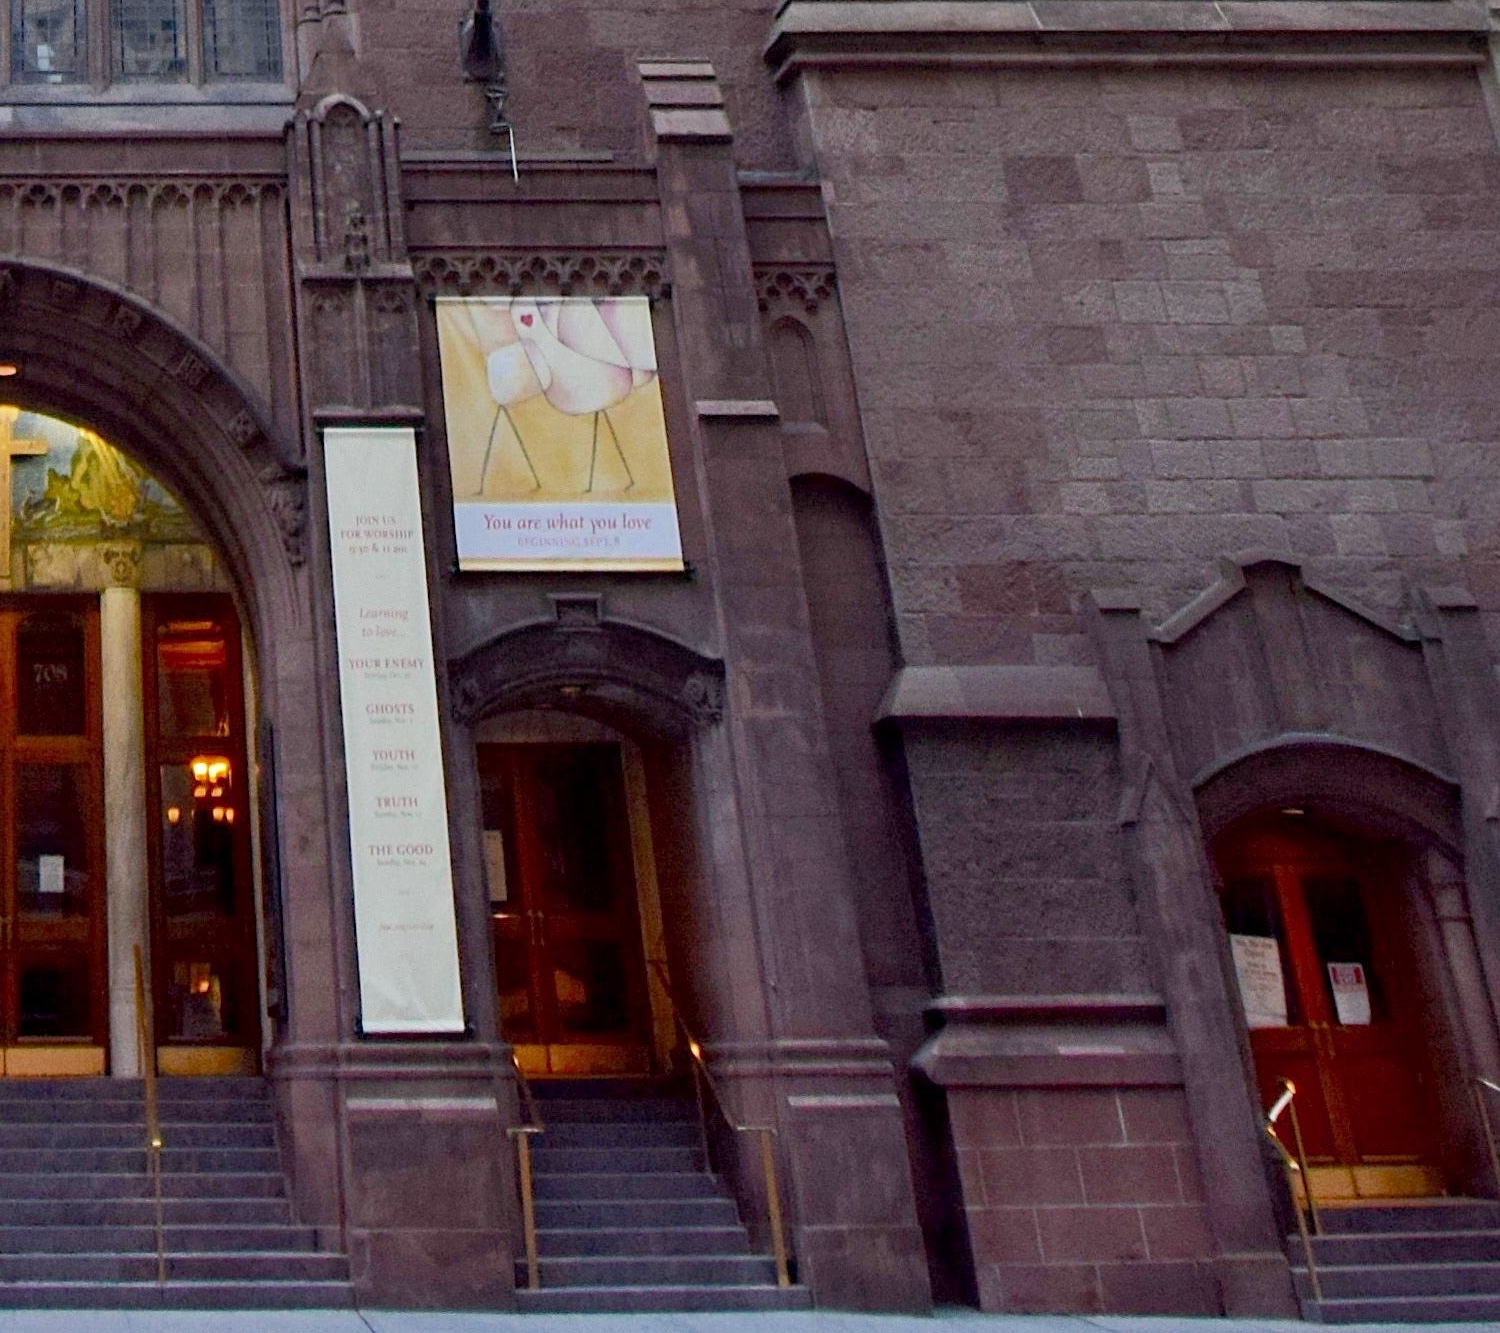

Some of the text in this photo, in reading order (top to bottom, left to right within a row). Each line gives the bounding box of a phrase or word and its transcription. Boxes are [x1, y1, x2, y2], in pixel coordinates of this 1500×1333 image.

[356, 516, 379, 527] JOIN
[484, 512, 653, 535] You are what you love
[364, 529, 414, 539] WORSHIP
[359, 607, 409, 622] Learning
[349, 658, 425, 670] YOUR ENEMY
[33, 661, 68, 684] 708
[366, 703, 415, 715] GHOSTS
[372, 748, 416, 761] YOUTH
[376, 796, 419, 808] TRUTH
[368, 844, 434, 856] THE GOOD
